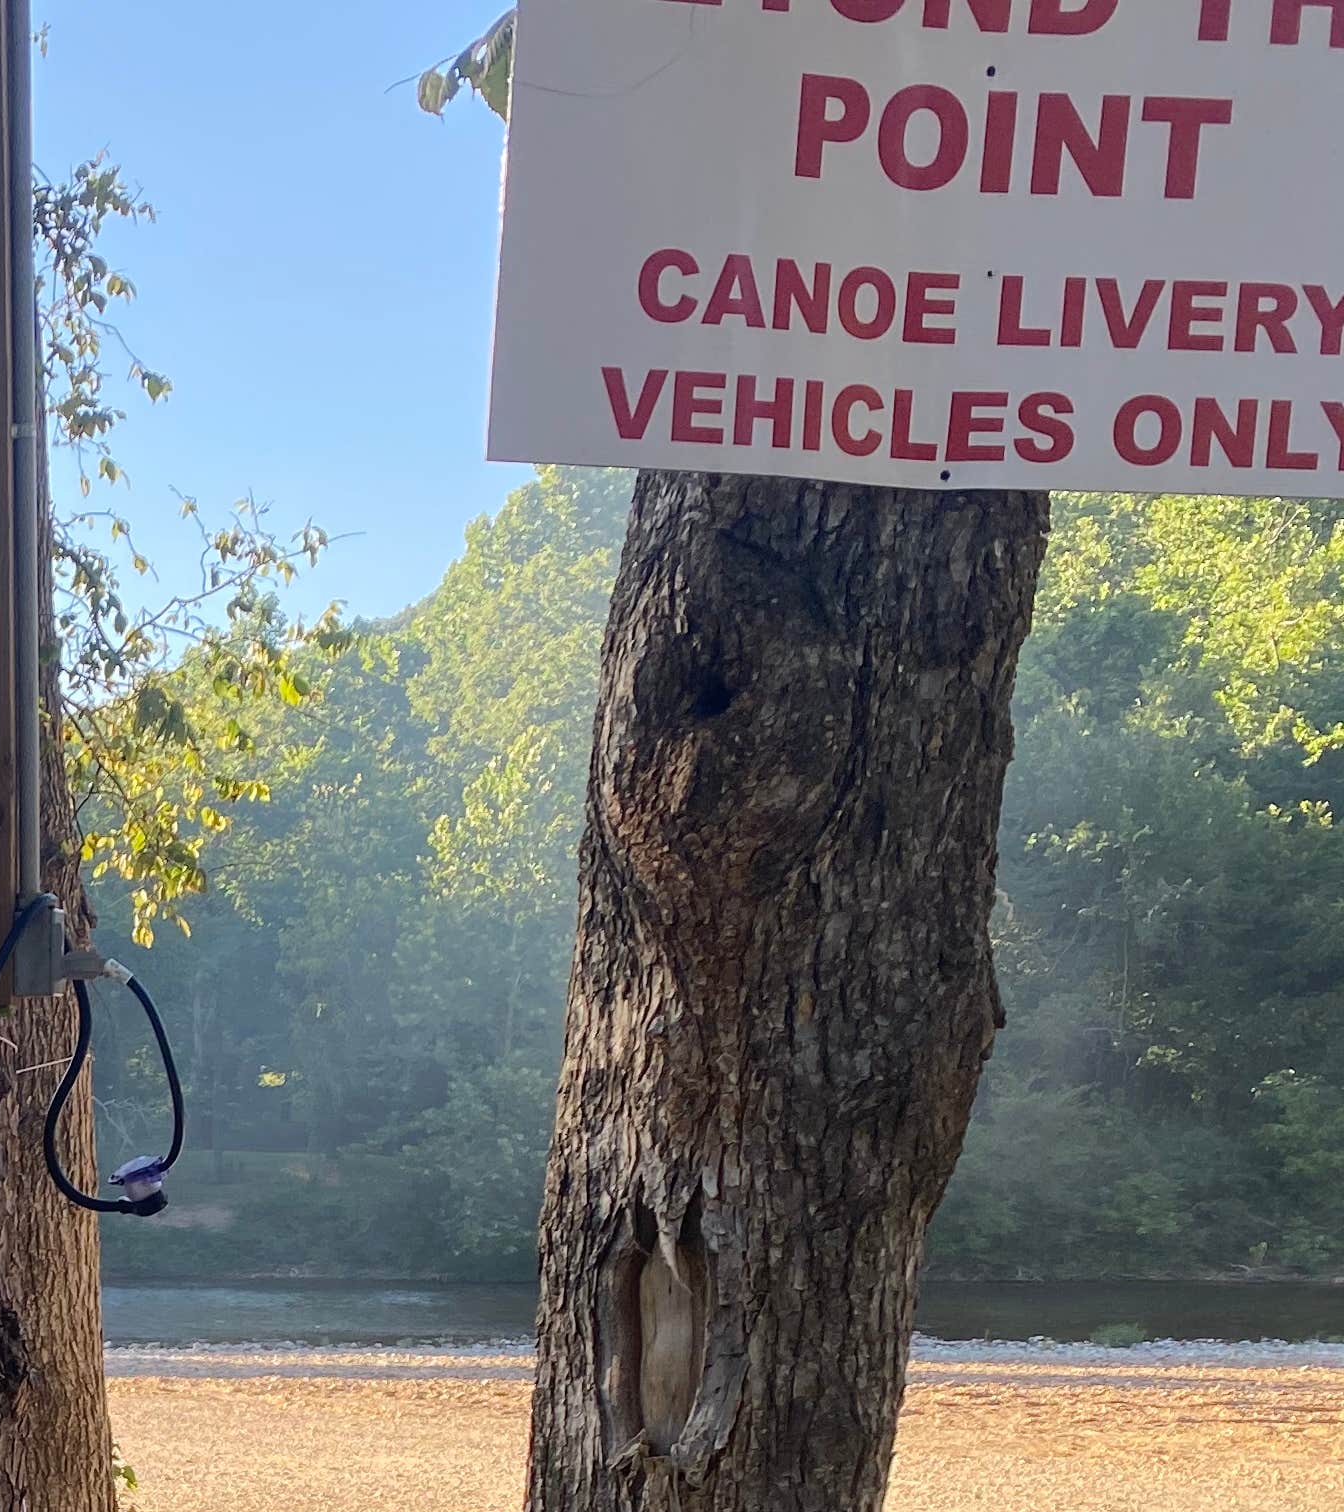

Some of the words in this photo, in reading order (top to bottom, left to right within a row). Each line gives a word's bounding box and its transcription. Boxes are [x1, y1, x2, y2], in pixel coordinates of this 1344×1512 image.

[795, 73, 1232, 200] POINT
[637, 248, 960, 344] CANOE
[997, 275, 1344, 355] LIVERY
[601, 366, 1074, 463] VEHICLES
